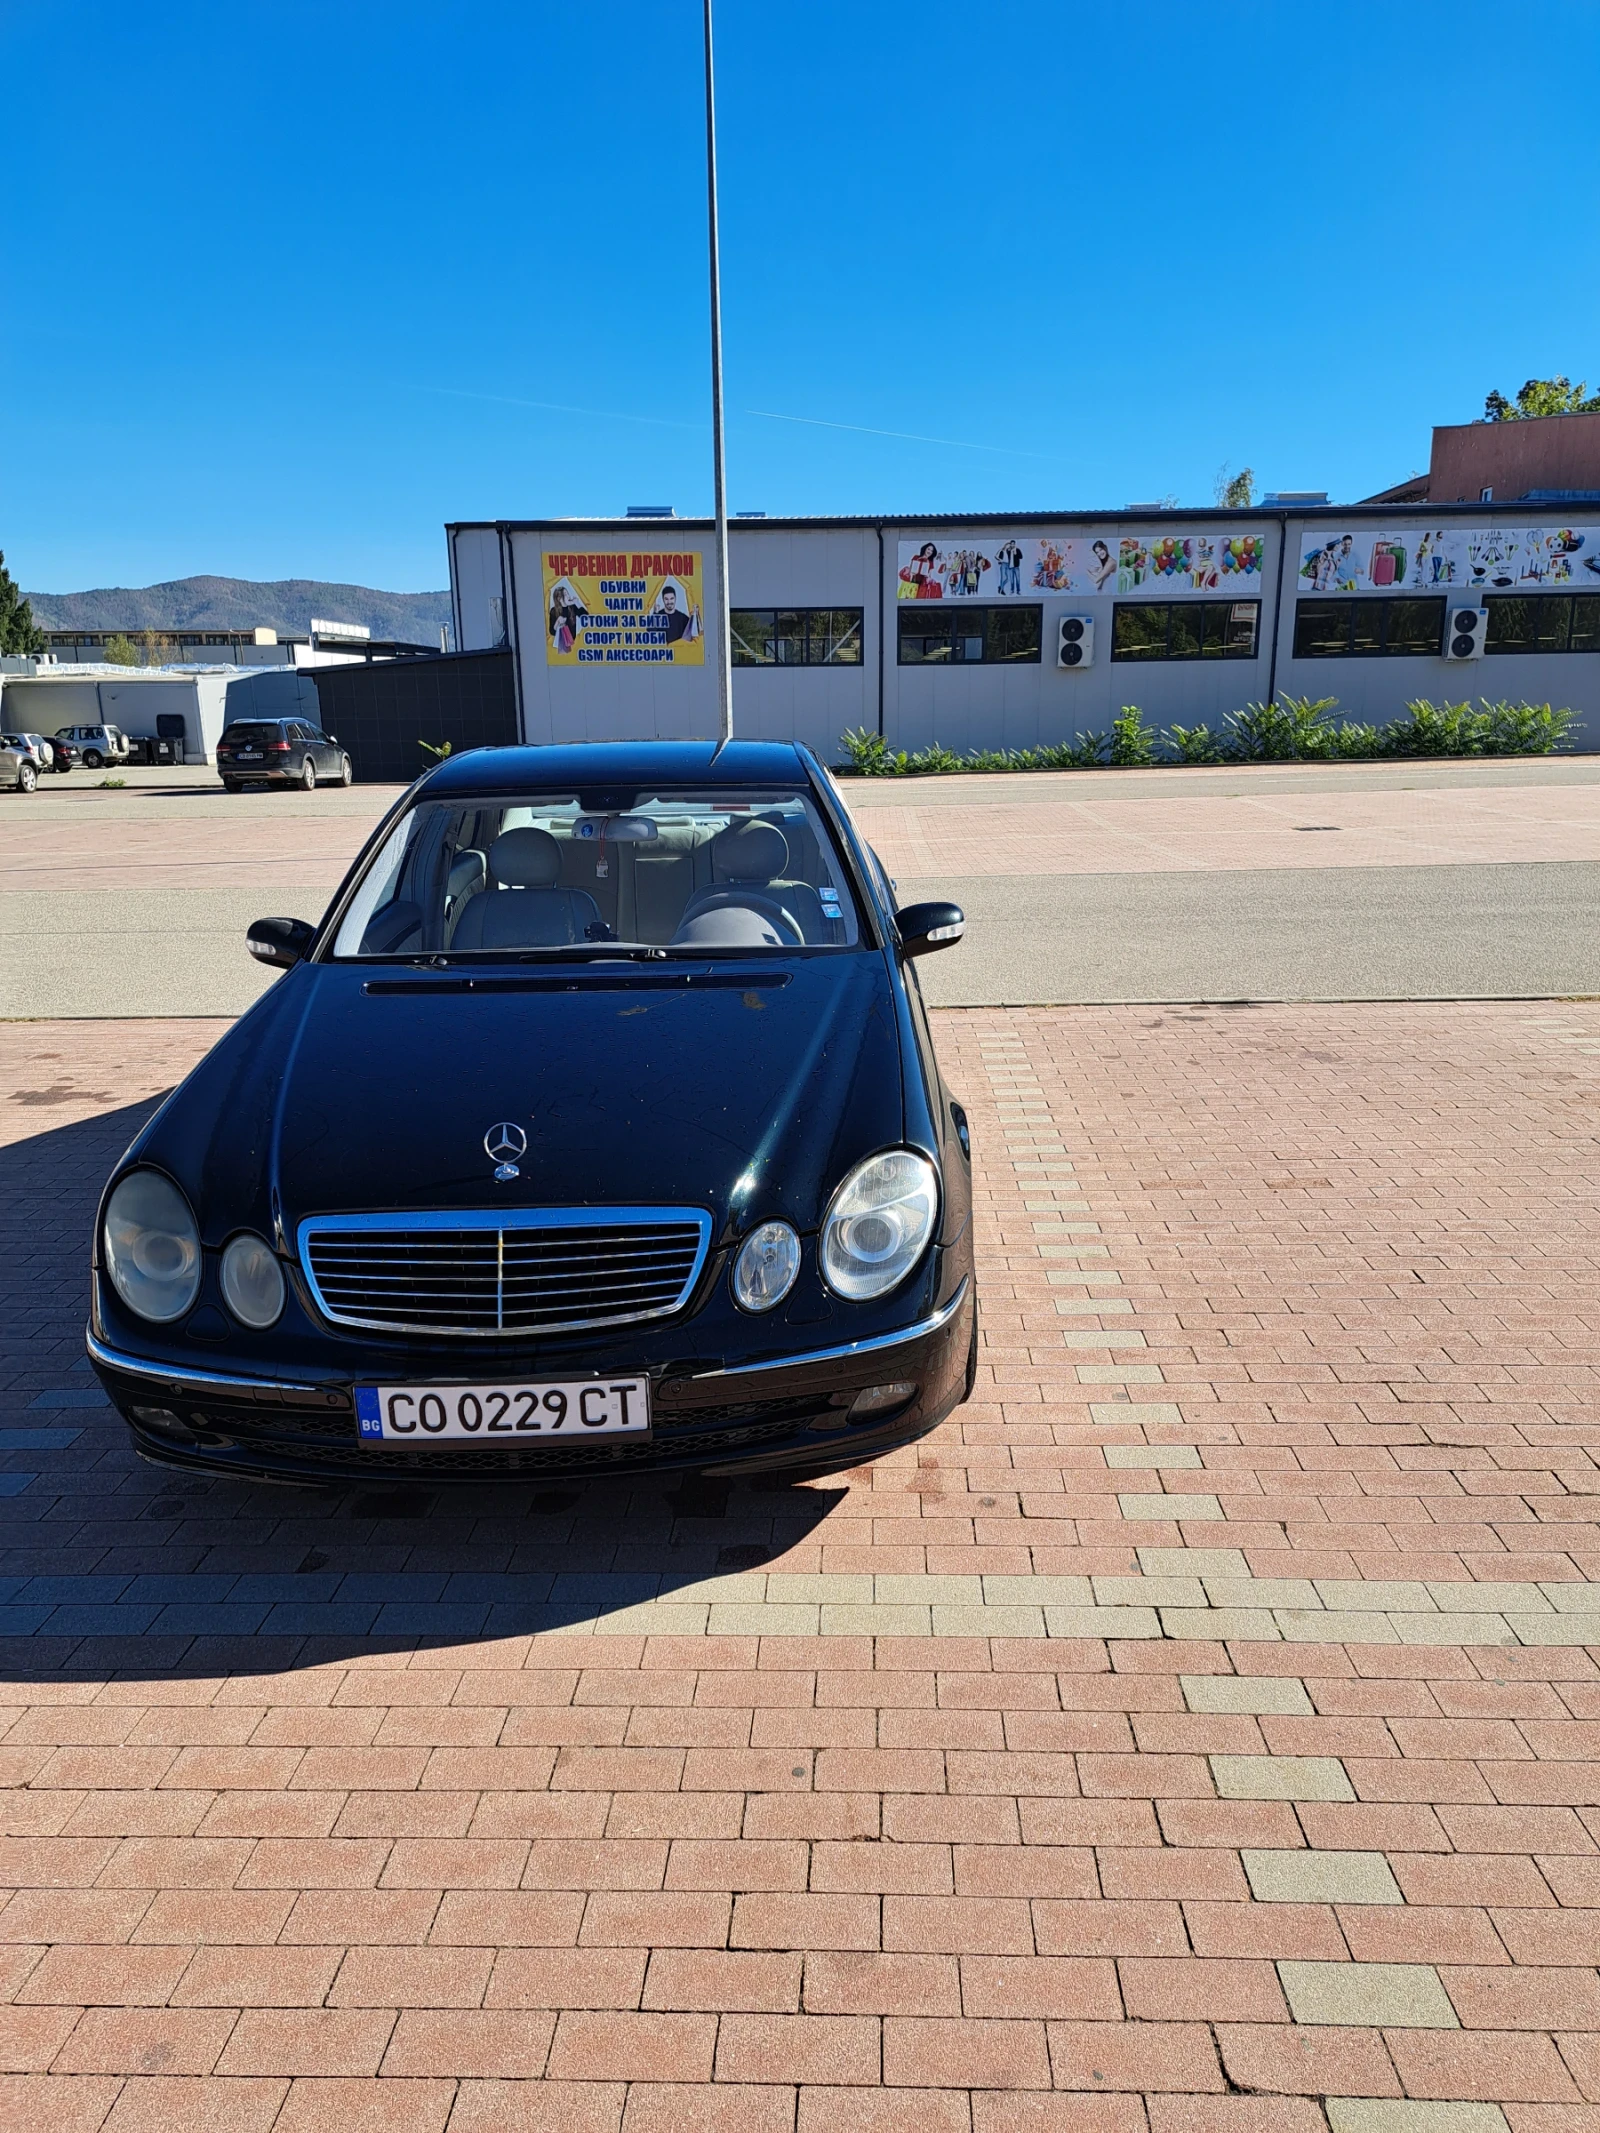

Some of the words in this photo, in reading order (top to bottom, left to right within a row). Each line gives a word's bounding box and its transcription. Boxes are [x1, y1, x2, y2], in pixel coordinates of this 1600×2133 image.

[548, 554, 627, 577] ЧЕРВЕНИЯ
[630, 554, 694, 579] ДРАКОН
[600, 581, 646, 593] ОБУВКИ
[605, 598, 643, 610] ЧАНТИ
[580, 615, 618, 627] СТОКИ
[621, 615, 636, 627] ЗА
[639, 615, 669, 627] БИТА
[584, 632, 622, 644] СПОРТ
[625, 632, 632, 644] И
[635, 632, 666, 644] ХОБИ
[578, 649, 603, 661] GSM
[606, 649, 673, 661] АКСЕСОАРИ
[387, 1393, 447, 1433] CO
[457, 1389, 568, 1432] 0229
[579, 1385, 637, 1427] CT
[362, 1419, 380, 1432] BG
